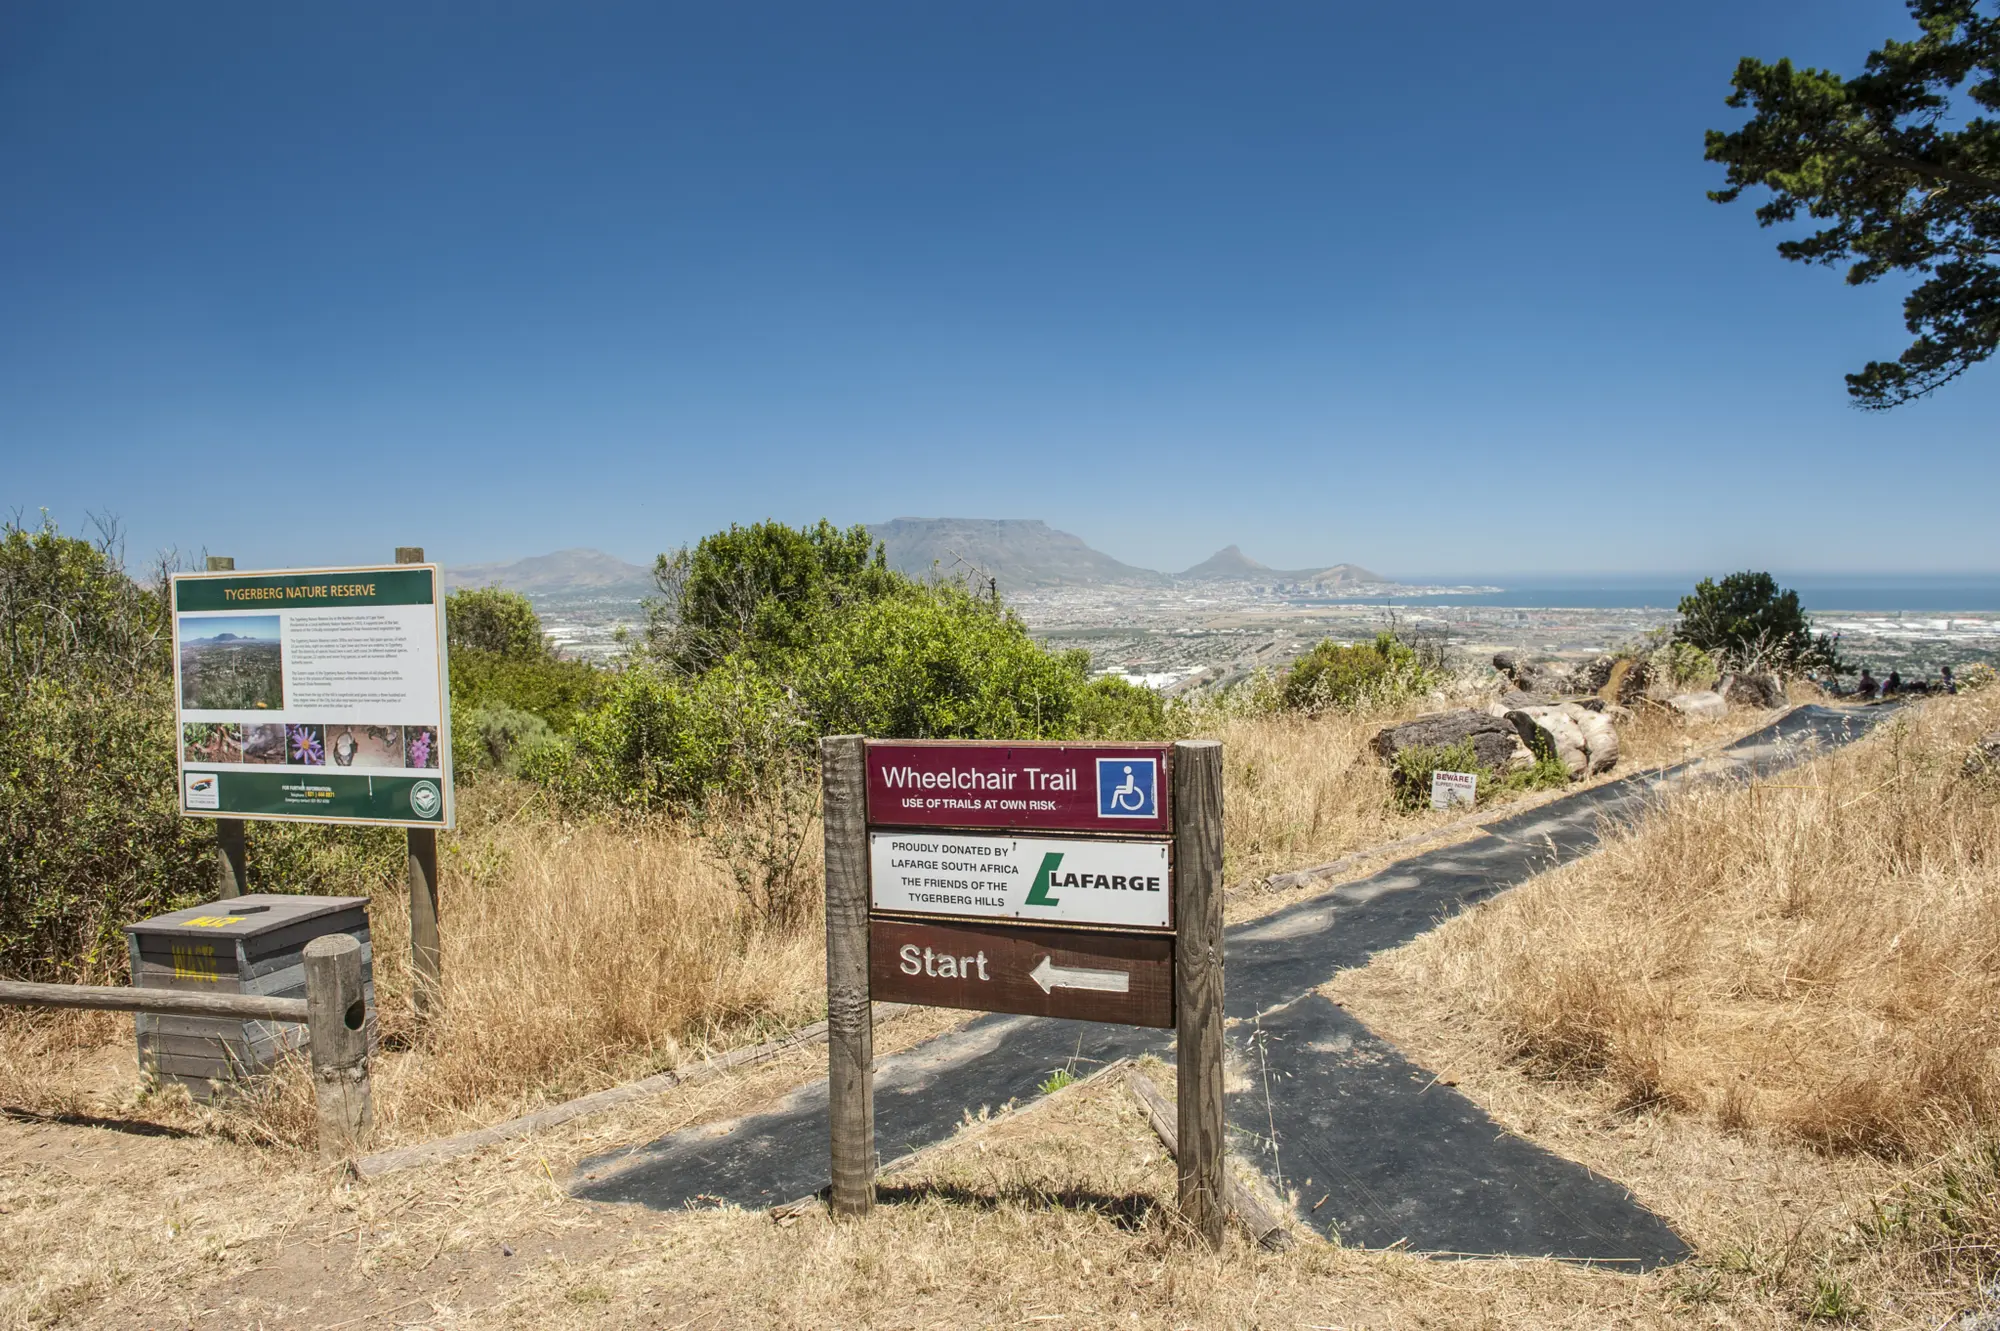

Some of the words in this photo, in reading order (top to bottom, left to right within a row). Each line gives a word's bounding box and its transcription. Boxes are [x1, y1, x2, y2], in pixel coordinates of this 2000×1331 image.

[224, 588, 283, 600] TYGERBERG
[286, 586, 328, 598] NATURE
[331, 584, 376, 597] RESERVE
[882, 767, 1017, 790] Wheelchair
[1023, 768, 1077, 791] Trail
[902, 798, 923, 808] USE
[926, 798, 941, 808] OF
[942, 799, 982, 810] TRAILS
[984, 800, 998, 810] AT
[1000, 800, 1027, 810] OWN
[1029, 800, 1056, 810] RISK
[892, 842, 939, 853] PROUDLY
[942, 844, 992, 856] DONATED
[994, 847, 1008, 856] BY
[891, 859, 939, 870] LAFARGE
[941, 862, 977, 872] SOUTH
[980, 863, 1019, 874] AFRICA
[901, 877, 922, 887] THE
[924, 878, 968, 889] FRIENDS
[971, 880, 986, 890] OF
[987, 881, 1008, 891] THE
[1050, 872, 1160, 891] LAFARGE
[909, 892, 972, 904] TYGERBERG
[974, 895, 1004, 906] HILLS
[900, 943, 990, 981] Start
